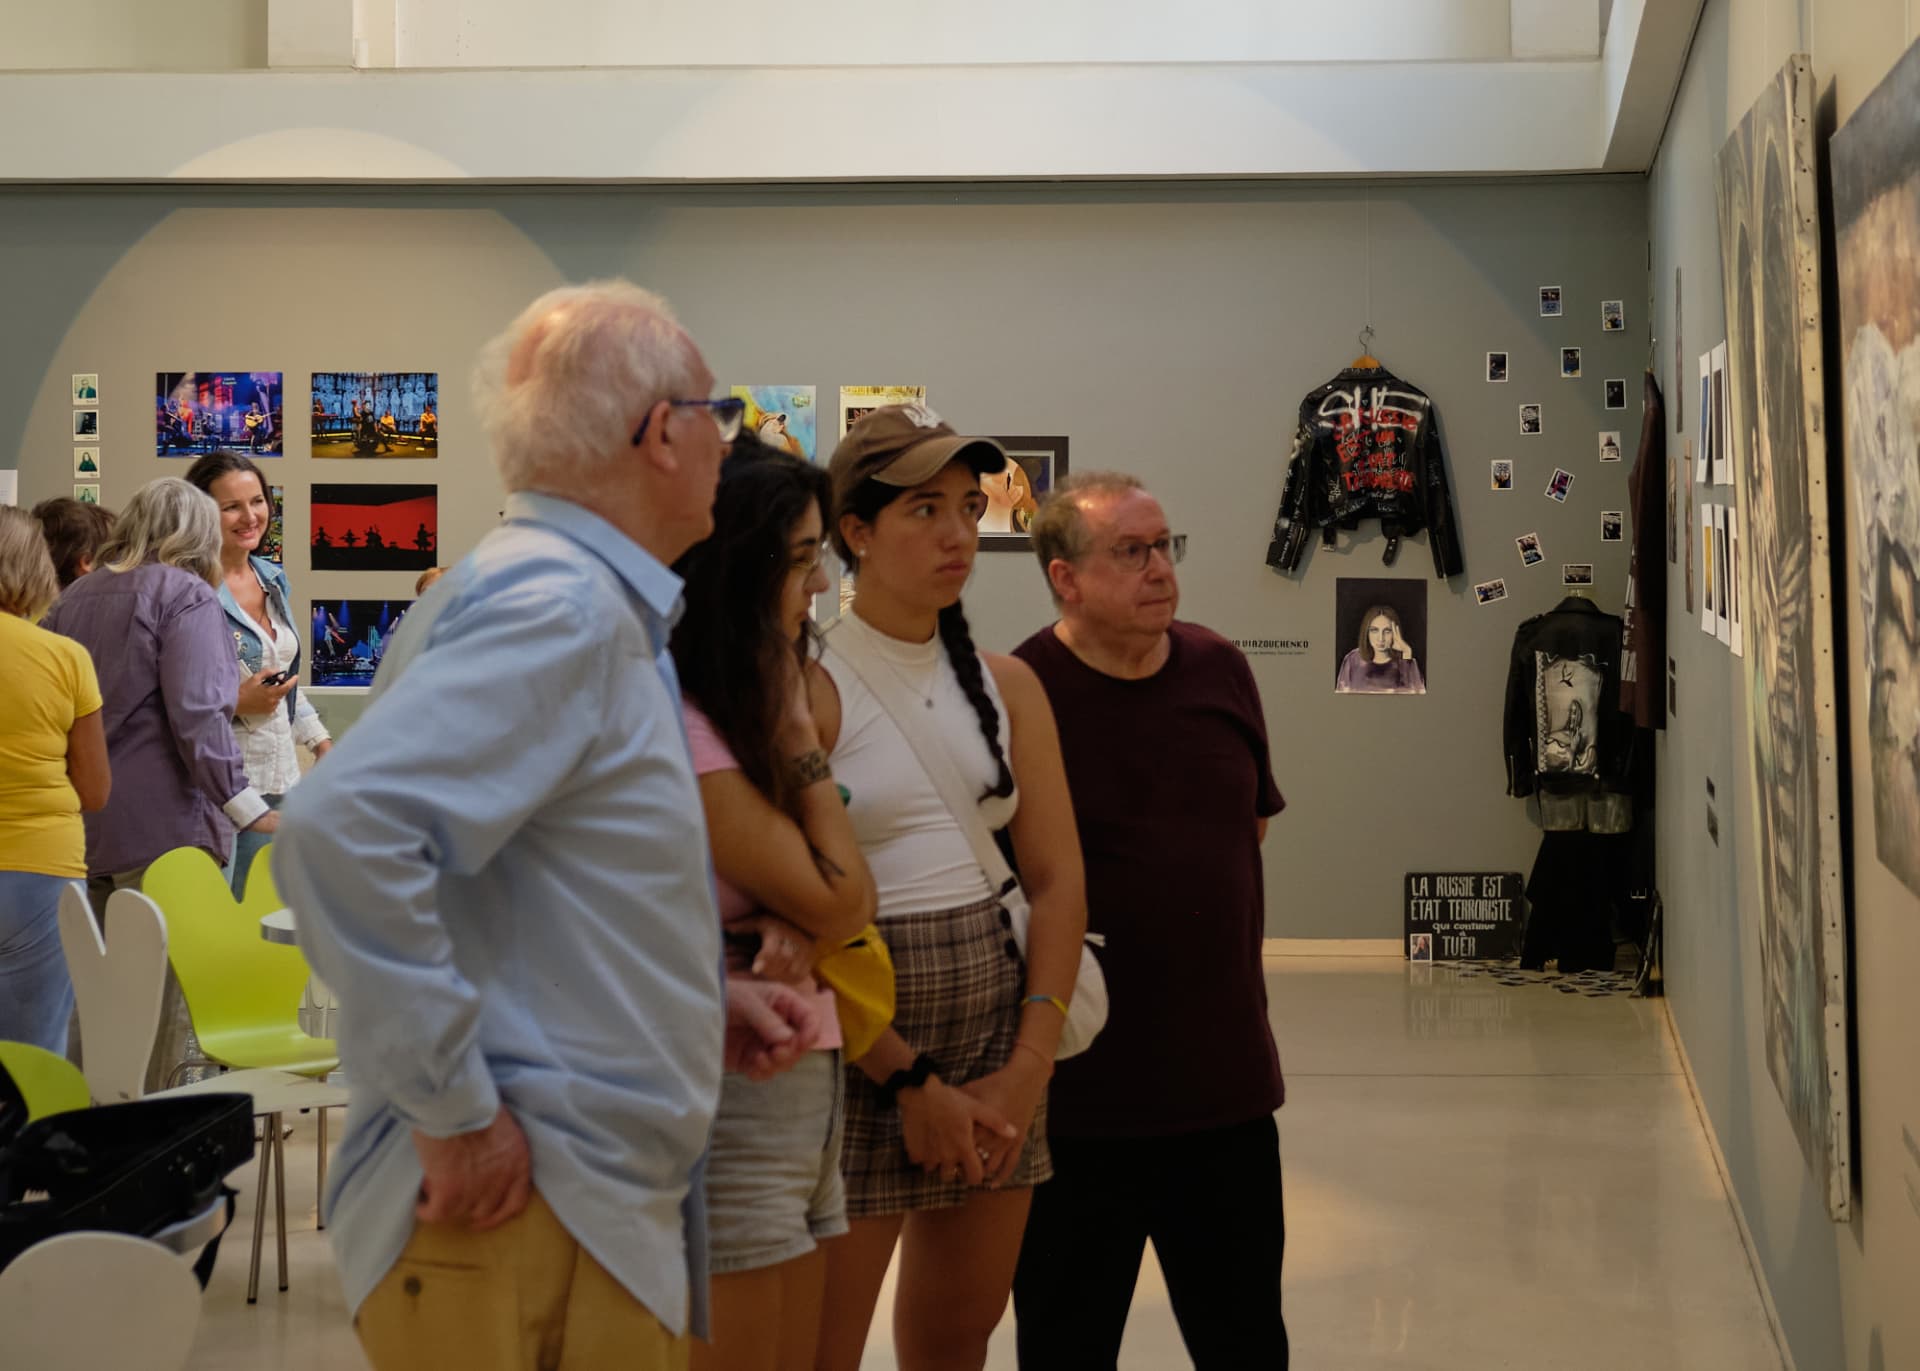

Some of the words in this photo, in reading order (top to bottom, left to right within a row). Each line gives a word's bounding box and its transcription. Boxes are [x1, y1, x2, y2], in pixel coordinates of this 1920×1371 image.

[1411, 876, 1429, 897] LA
[1436, 875, 1475, 897] RUSSIE
[1482, 875, 1504, 897] EST
[1448, 899, 1513, 921] TERRORISTE
[1432, 922, 1450, 934] qui
[1453, 922, 1496, 930] continue
